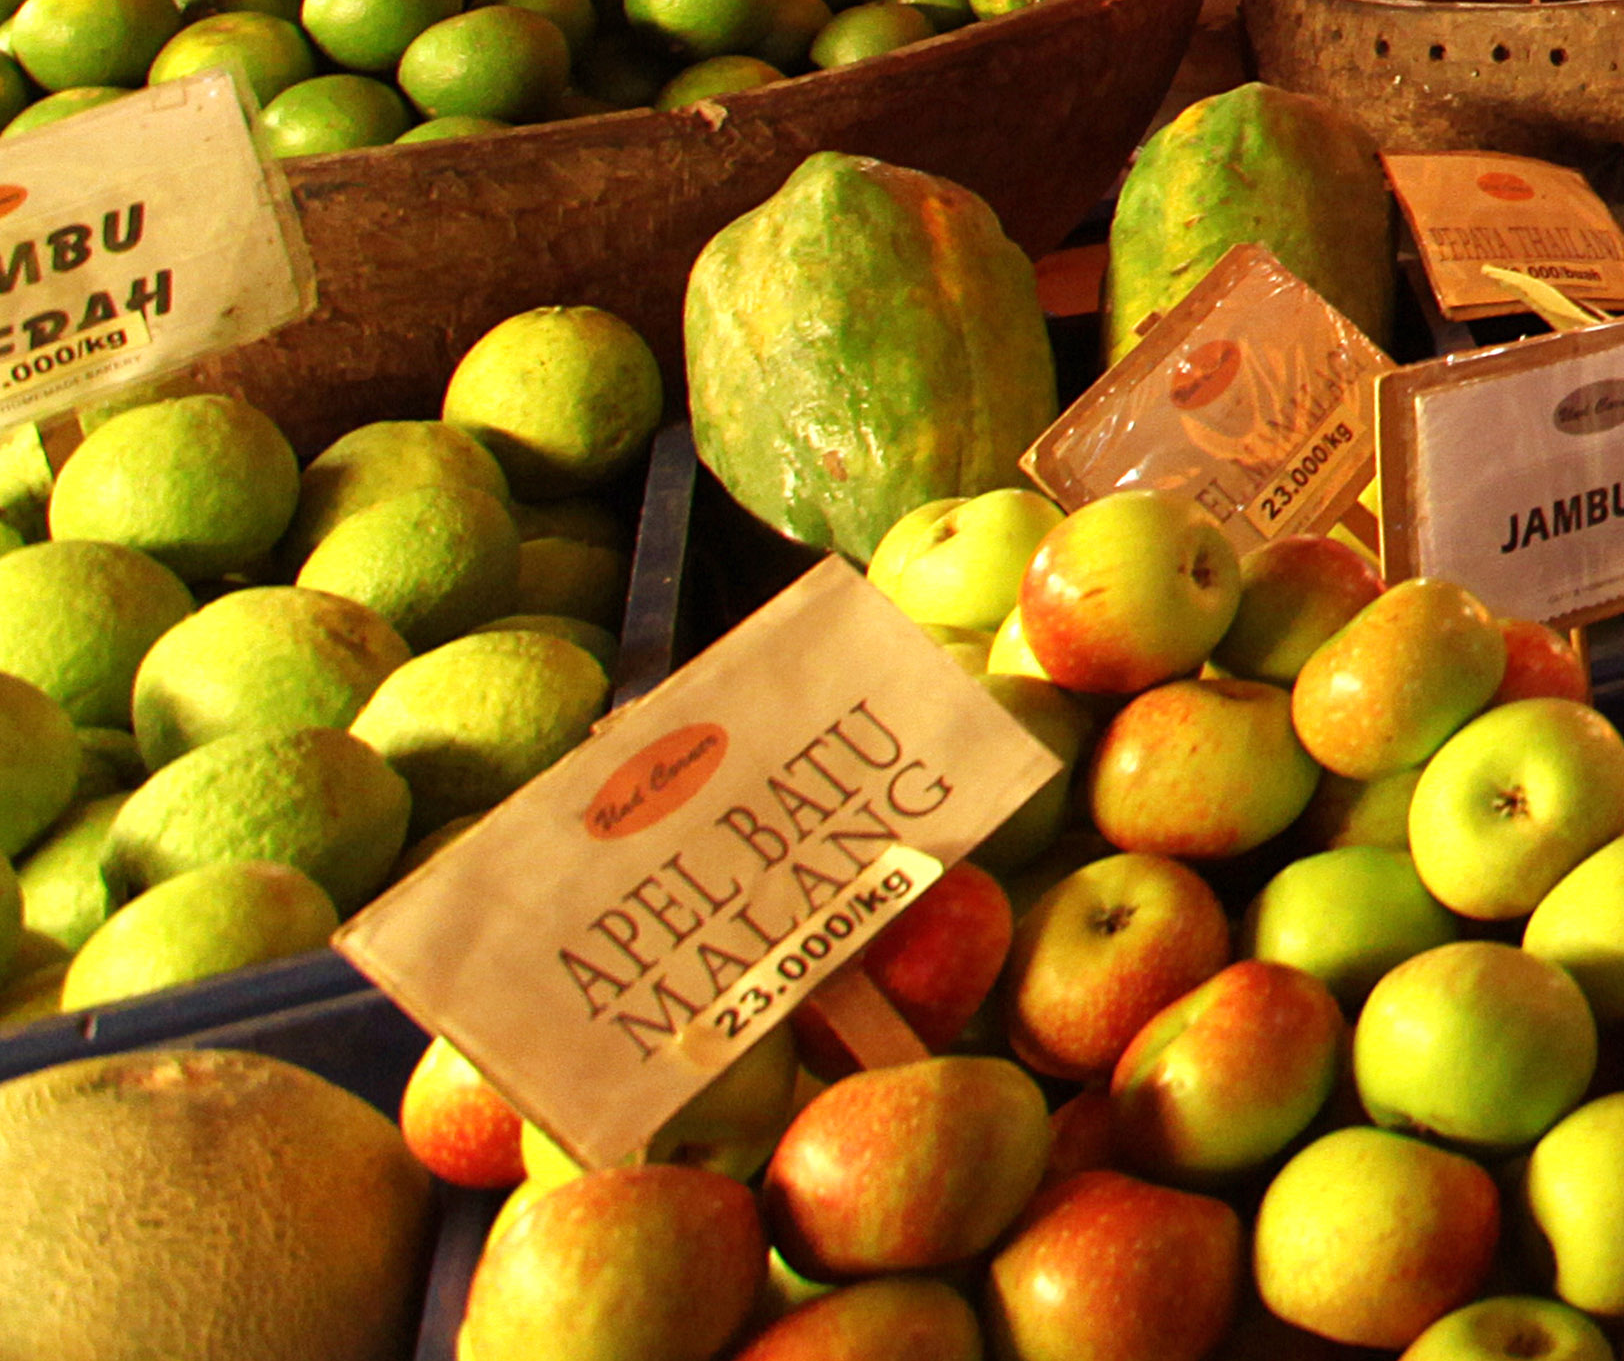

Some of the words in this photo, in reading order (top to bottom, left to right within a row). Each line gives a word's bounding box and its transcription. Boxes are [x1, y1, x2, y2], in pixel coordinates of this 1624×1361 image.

[0, 201, 145, 295] MBU
[1427, 225, 1510, 264] PEPAYA
[559, 852, 742, 1021] APEL
[715, 699, 907, 874] BATU
[610, 759, 955, 1063] MALANG
[715, 866, 914, 1041] 23.000/kg
